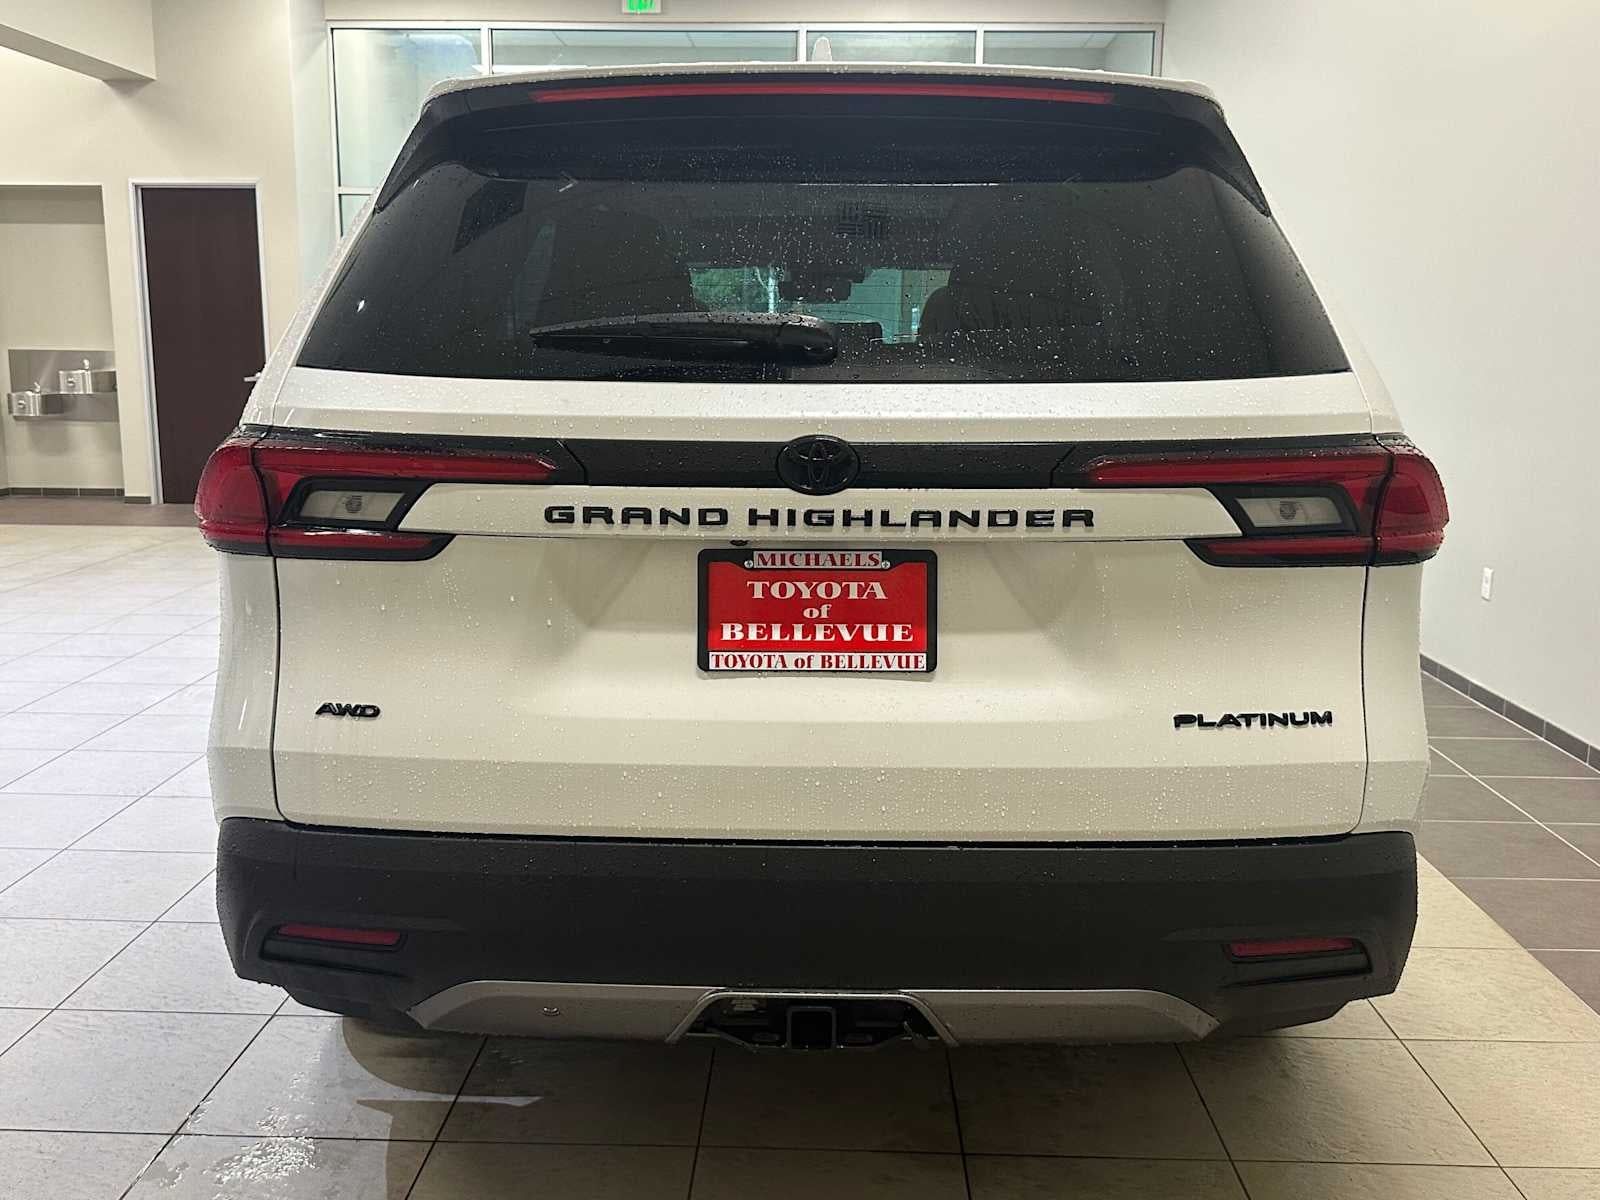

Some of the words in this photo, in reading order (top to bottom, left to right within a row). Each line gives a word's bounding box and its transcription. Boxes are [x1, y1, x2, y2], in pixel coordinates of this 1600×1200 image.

[544, 506, 728, 526] GRAND
[748, 508, 1094, 528] HIGHLANDER
[757, 553, 881, 567] MICHAELS
[747, 581, 888, 599] TOYOTA
[803, 604, 832, 618] of
[720, 623, 913, 641] BELLEVUE
[711, 654, 789, 668] TOYOTA
[794, 653, 815, 668] of
[820, 655, 925, 669] BELLEVUE
[315, 702, 380, 717] AWD
[1173, 711, 1333, 728] PLATINUM
